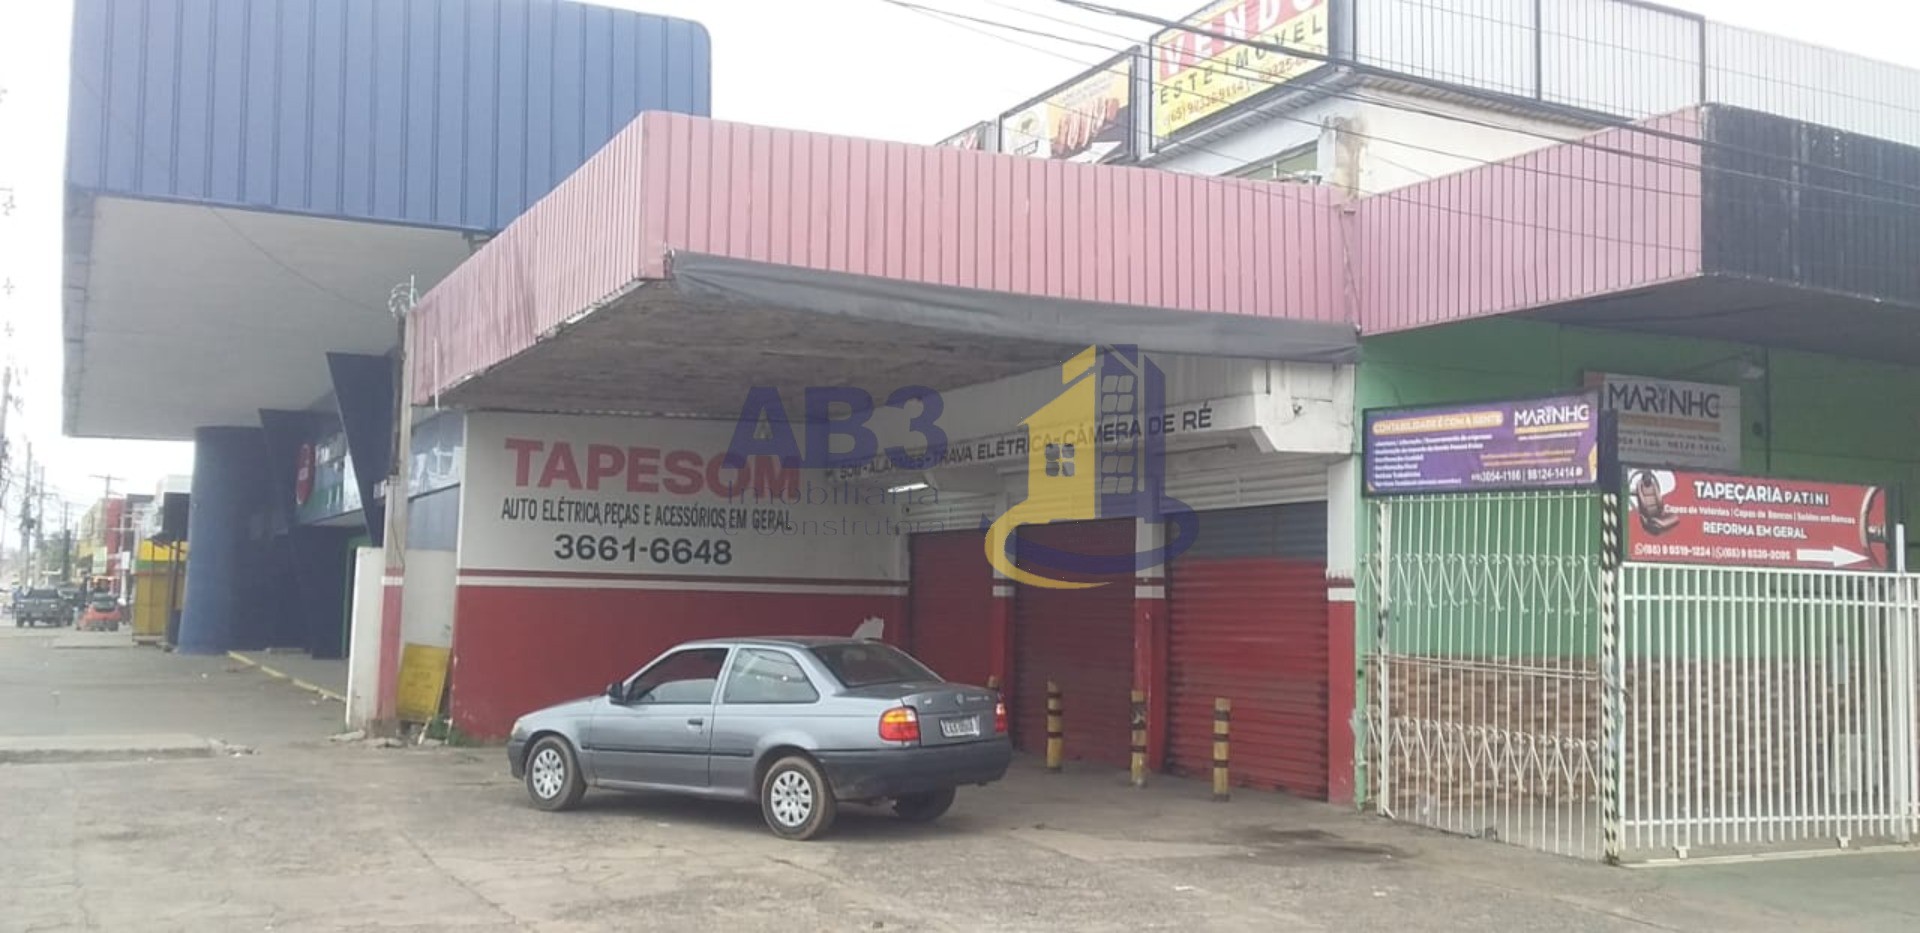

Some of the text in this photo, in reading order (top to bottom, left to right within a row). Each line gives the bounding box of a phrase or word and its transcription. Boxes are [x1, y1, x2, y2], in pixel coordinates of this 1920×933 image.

[1160, 64, 1213, 105] ESTE
[1148, 413, 1175, 435] DE
[1182, 401, 1213, 431] RÉ
[504, 437, 799, 499] TAPESOM
[1694, 480, 1829, 506] TAPEÇARIA PATINI
[502, 498, 538, 520] AUTO
[604, 502, 640, 528] PEÇAS
[644, 503, 651, 526] E
[655, 503, 726, 529] ACESSÓRIOS
[729, 507, 747, 529] EM
[752, 508, 793, 531] GERAL
[1703, 521, 1808, 539] REFORMA EM GERAL
[554, 533, 733, 566] 3661-6648
